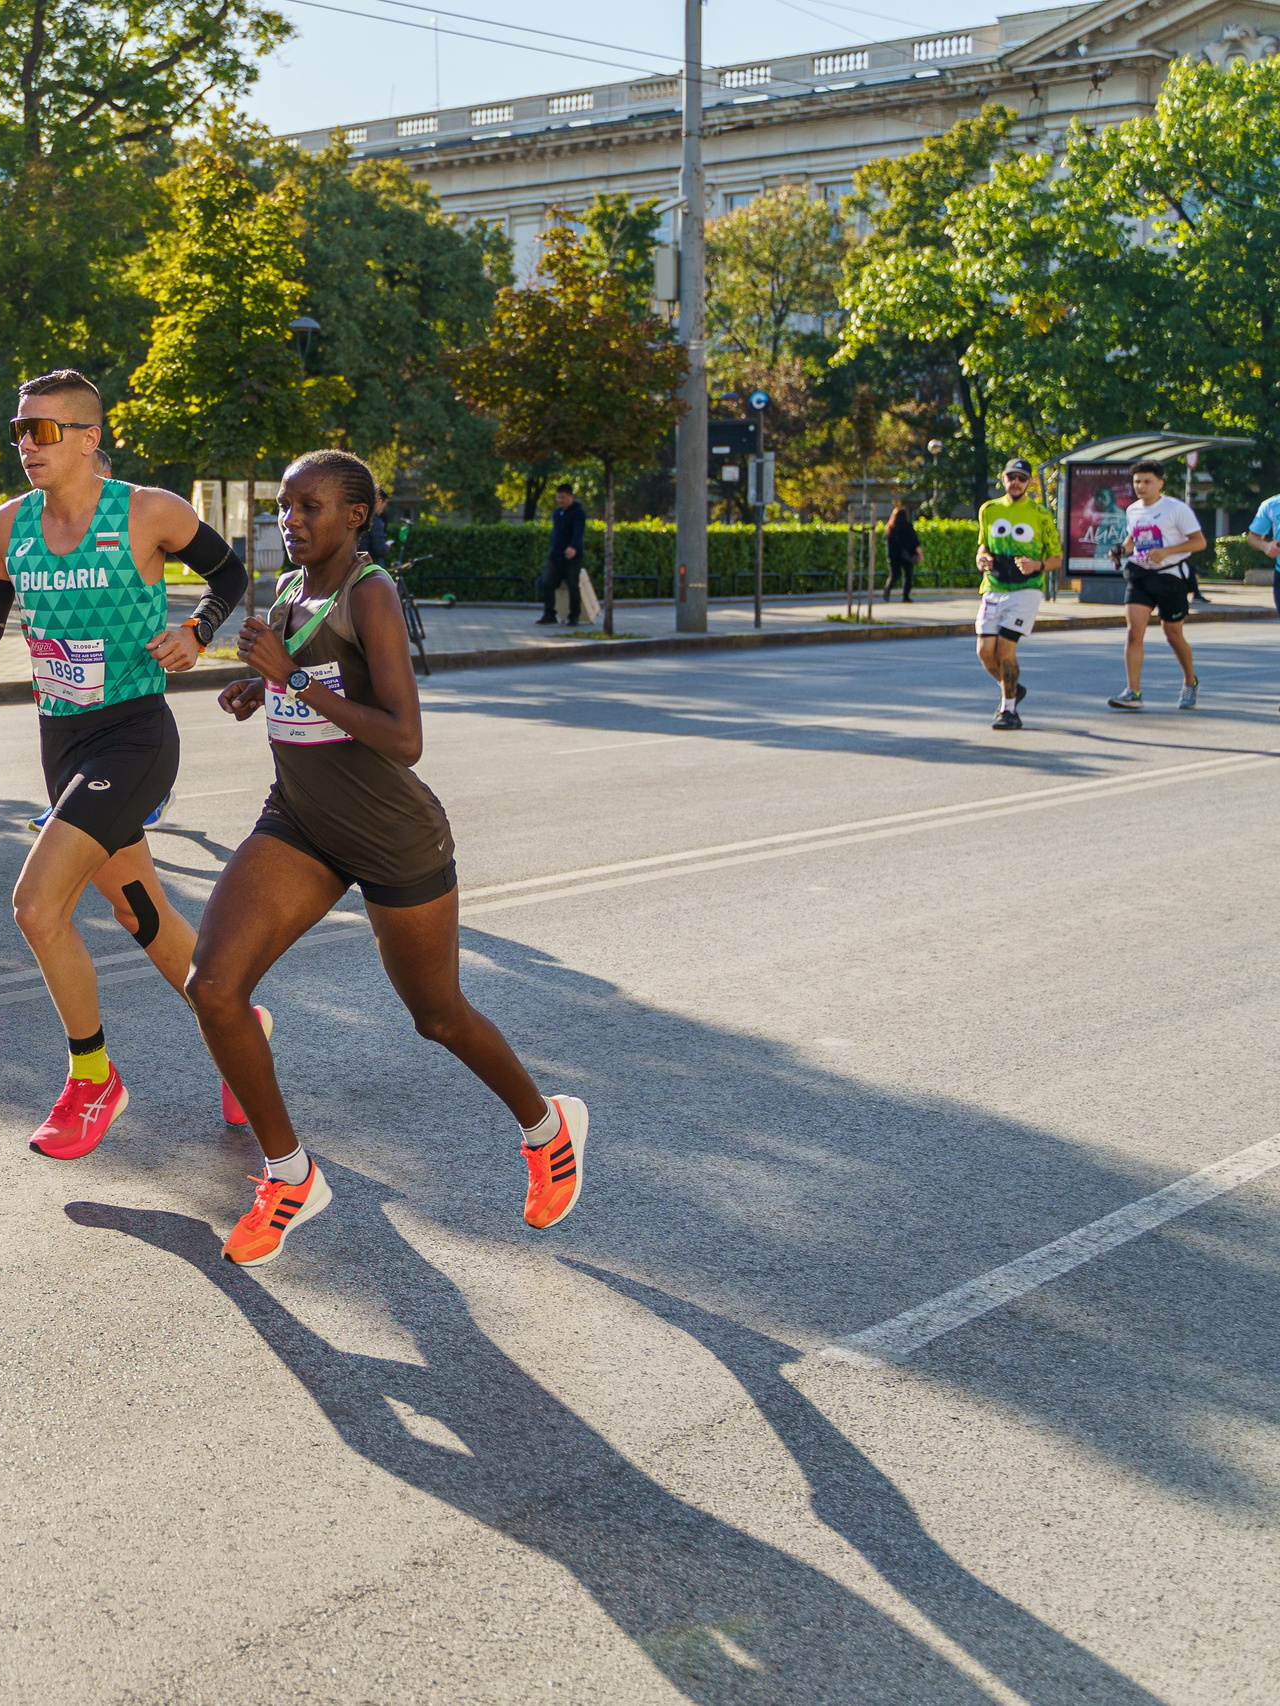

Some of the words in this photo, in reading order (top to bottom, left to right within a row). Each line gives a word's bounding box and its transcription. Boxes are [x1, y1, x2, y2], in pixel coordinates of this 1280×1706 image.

[20, 567, 109, 591] BULGARIA
[45, 659, 86, 684] 1898
[323, 678, 339, 686] SOFIA
[328, 682, 340, 690] 2023
